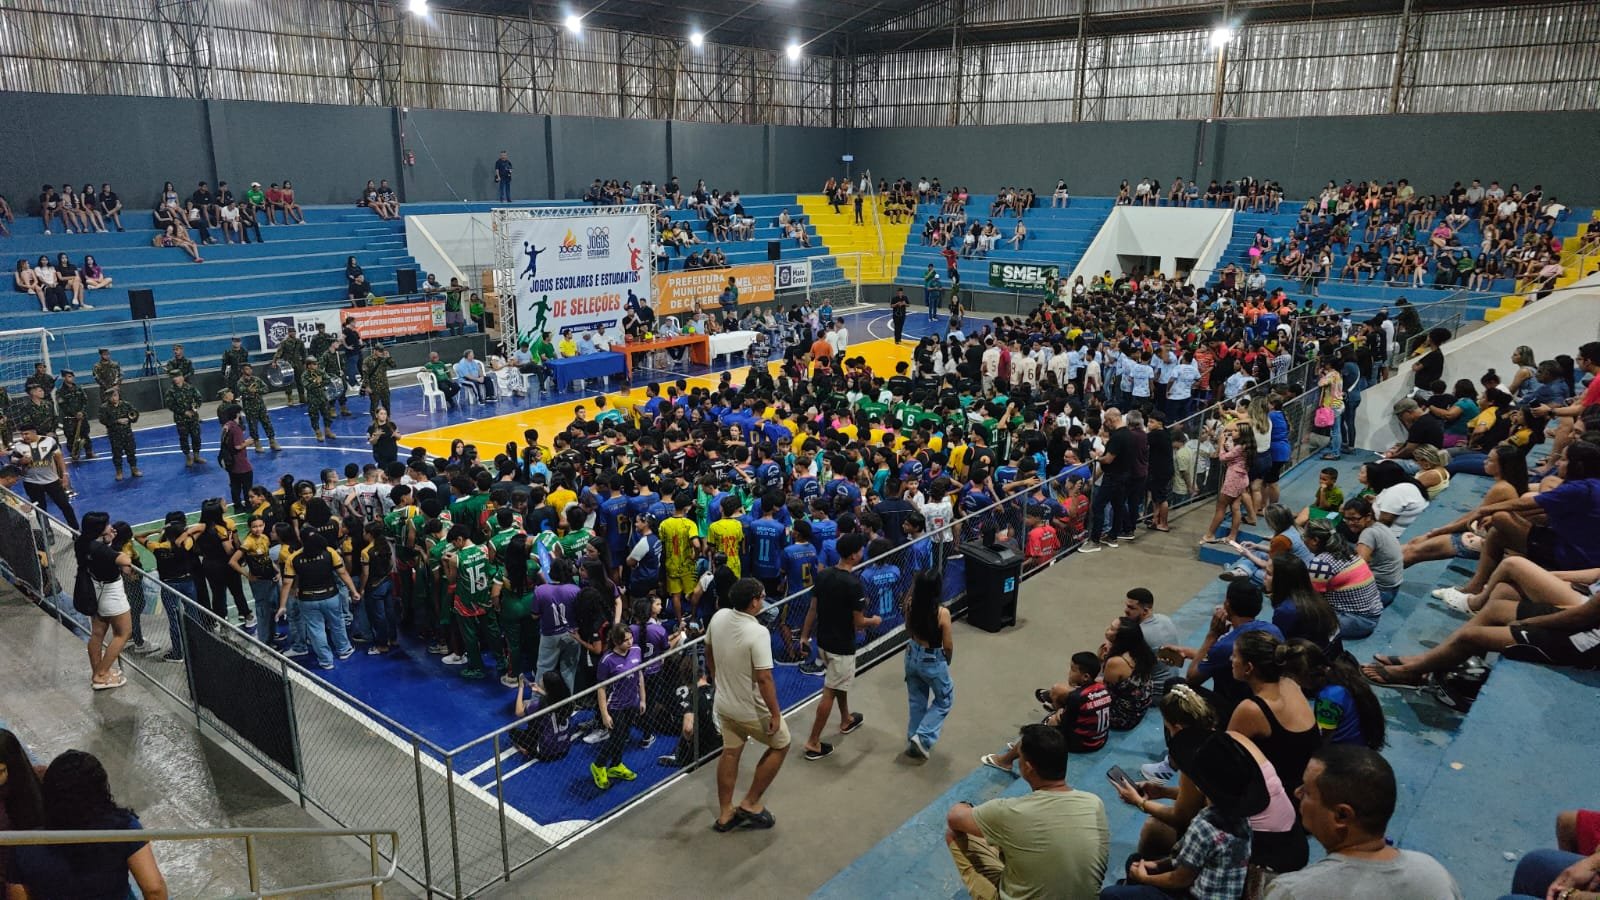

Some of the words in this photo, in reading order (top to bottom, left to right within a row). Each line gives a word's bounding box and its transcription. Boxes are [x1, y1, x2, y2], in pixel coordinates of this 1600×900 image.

[559, 244, 582, 253] JOGOS
[587, 234, 609, 249] JOGOS
[669, 274, 725, 288] PREFEITURA
[1003, 265, 1046, 281] SMEL
[530, 278, 553, 293] JOGOS
[555, 274, 593, 290] ESCOLARES
[595, 273, 599, 286] E
[601, 271, 638, 286] ESTUDANTIS
[673, 284, 721, 297] MUNICIPAL
[553, 299, 567, 317] DE
[570, 292, 620, 317] SELEÇÕES
[671, 299, 682, 308] DE
[759, 539, 770, 561] 11
[466, 562, 487, 594] 15
[1096, 706, 1110, 734] 10
